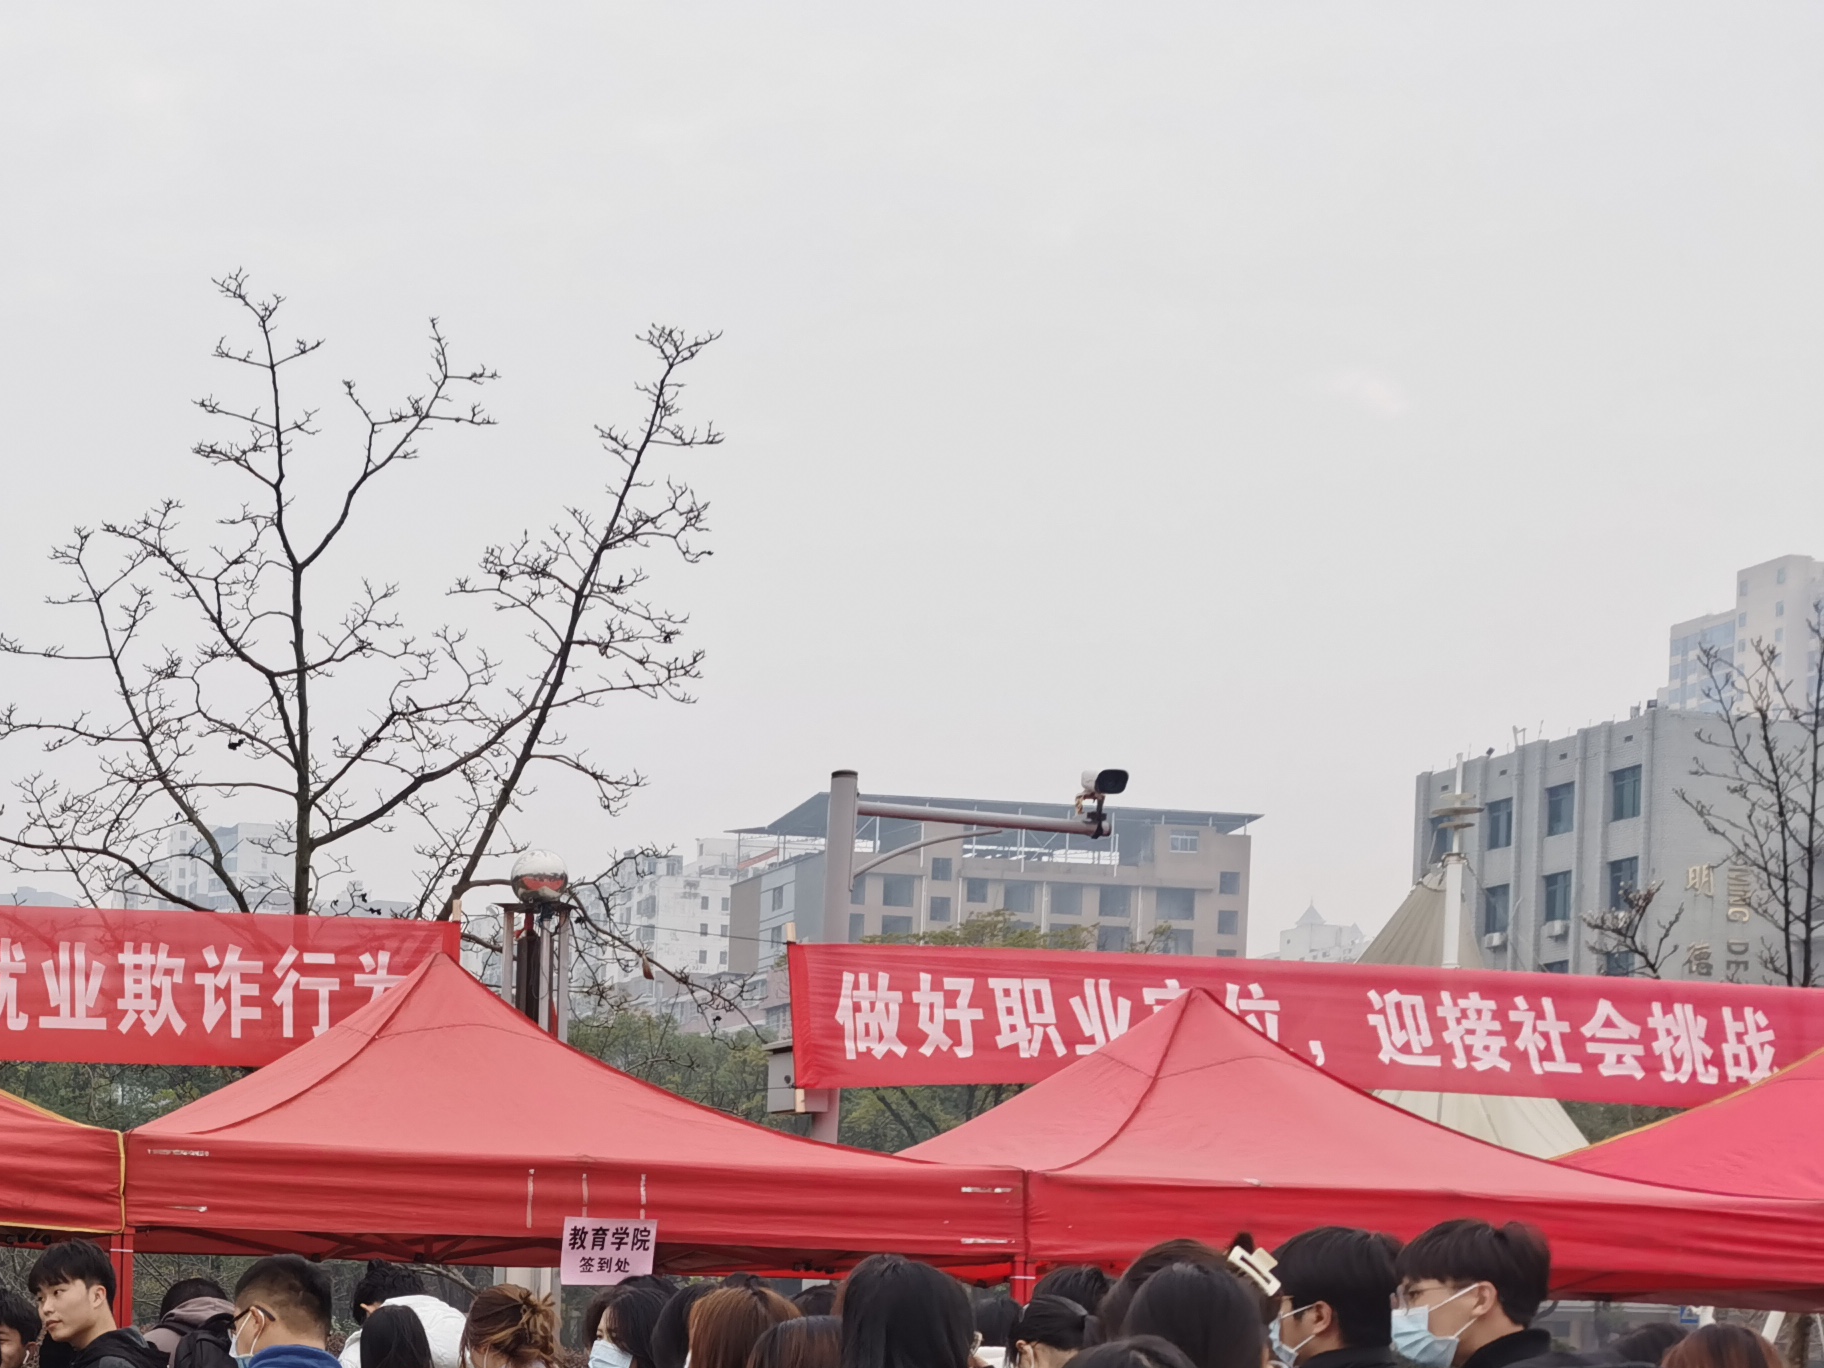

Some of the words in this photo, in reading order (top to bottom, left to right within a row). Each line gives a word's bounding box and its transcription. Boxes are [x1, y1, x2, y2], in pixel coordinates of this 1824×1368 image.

[568, 1226, 651, 1252] 教育学院
[579, 1256, 631, 1274] 签到处
